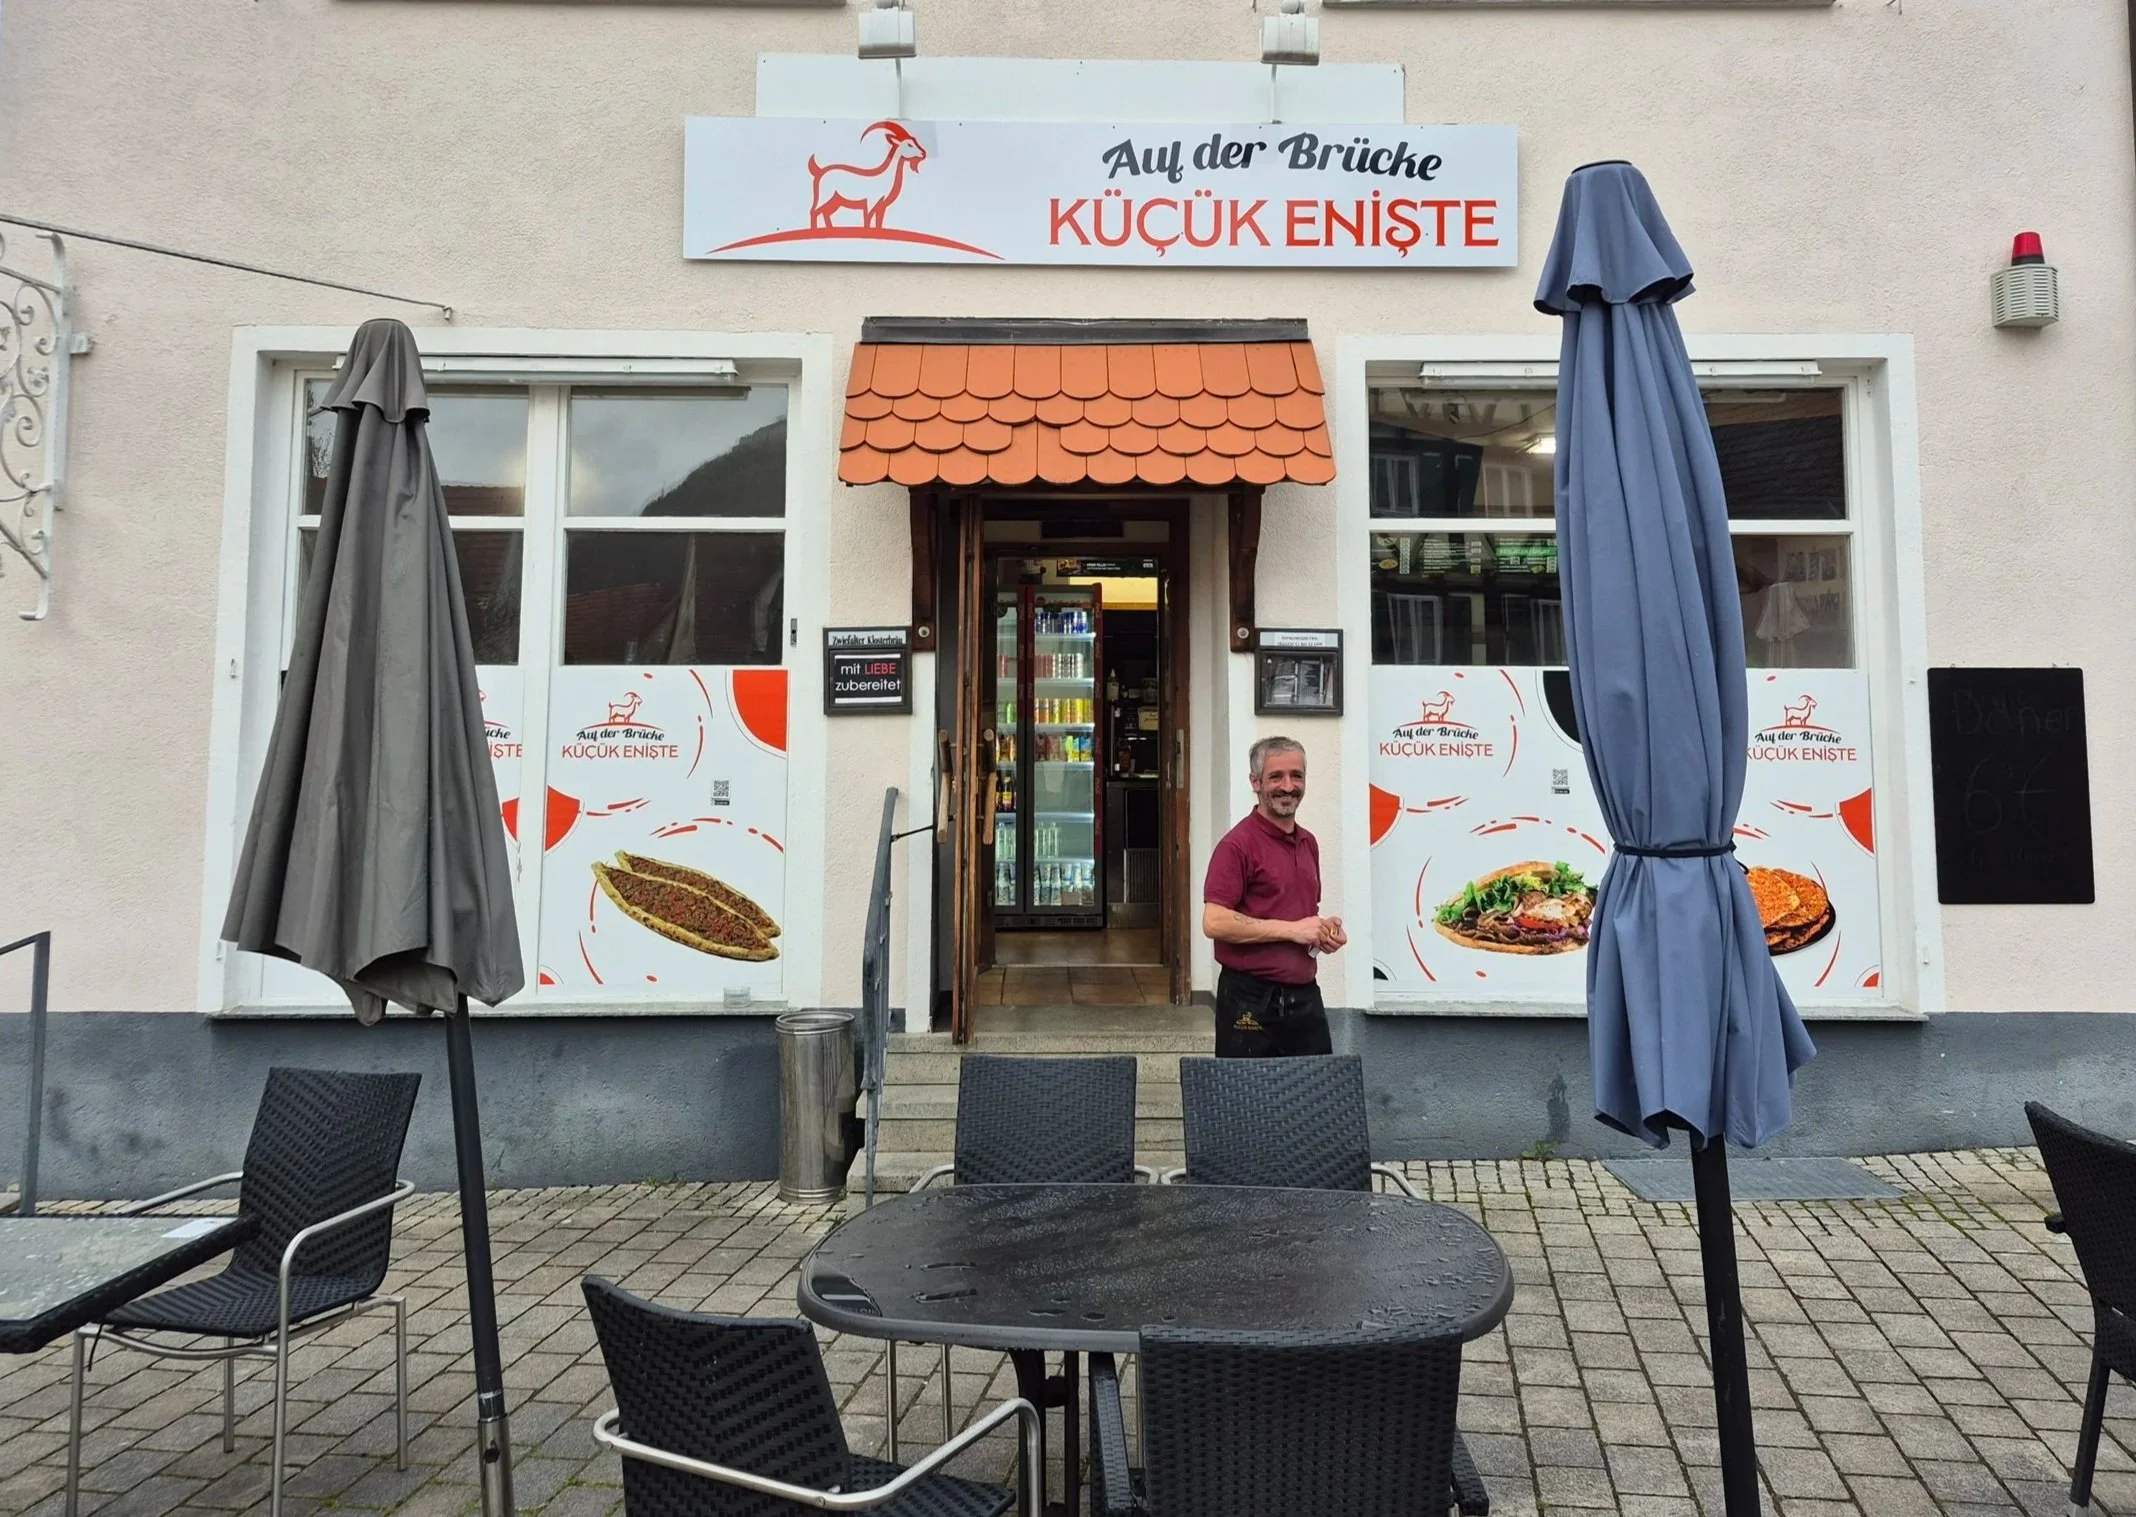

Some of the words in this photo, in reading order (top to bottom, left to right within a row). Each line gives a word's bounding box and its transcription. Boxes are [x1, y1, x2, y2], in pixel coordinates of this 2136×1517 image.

[1102, 138, 1183, 184] Auf
[1193, 133, 1267, 169] der
[1278, 132, 1443, 181] Brücke
[1049, 189, 1271, 257] KÜÇÜK
[1285, 190, 1500, 257] ENİŞTE
[840, 663, 861, 675] mit
[864, 662, 897, 675] LIEBE
[835, 679, 901, 691] zubereitet
[576, 730, 598, 742] Auf
[600, 728, 620, 739] der
[622, 728, 665, 741] Brücke
[1392, 728, 1414, 740] Auf
[1415, 726, 1435, 737] der
[1437, 726, 1480, 740] Brücke
[1754, 732, 1776, 745] Auf
[1777, 731, 1798, 741] der
[1799, 731, 1842, 744] Brücke
[562, 742, 620, 760] KÜÇÜK
[623, 742, 679, 760] ENİŞTE
[1379, 740, 1436, 758] KÜÇÜK
[1439, 741, 1494, 758] ENİŞTE
[1802, 745, 1857, 763] ENİŞTE
